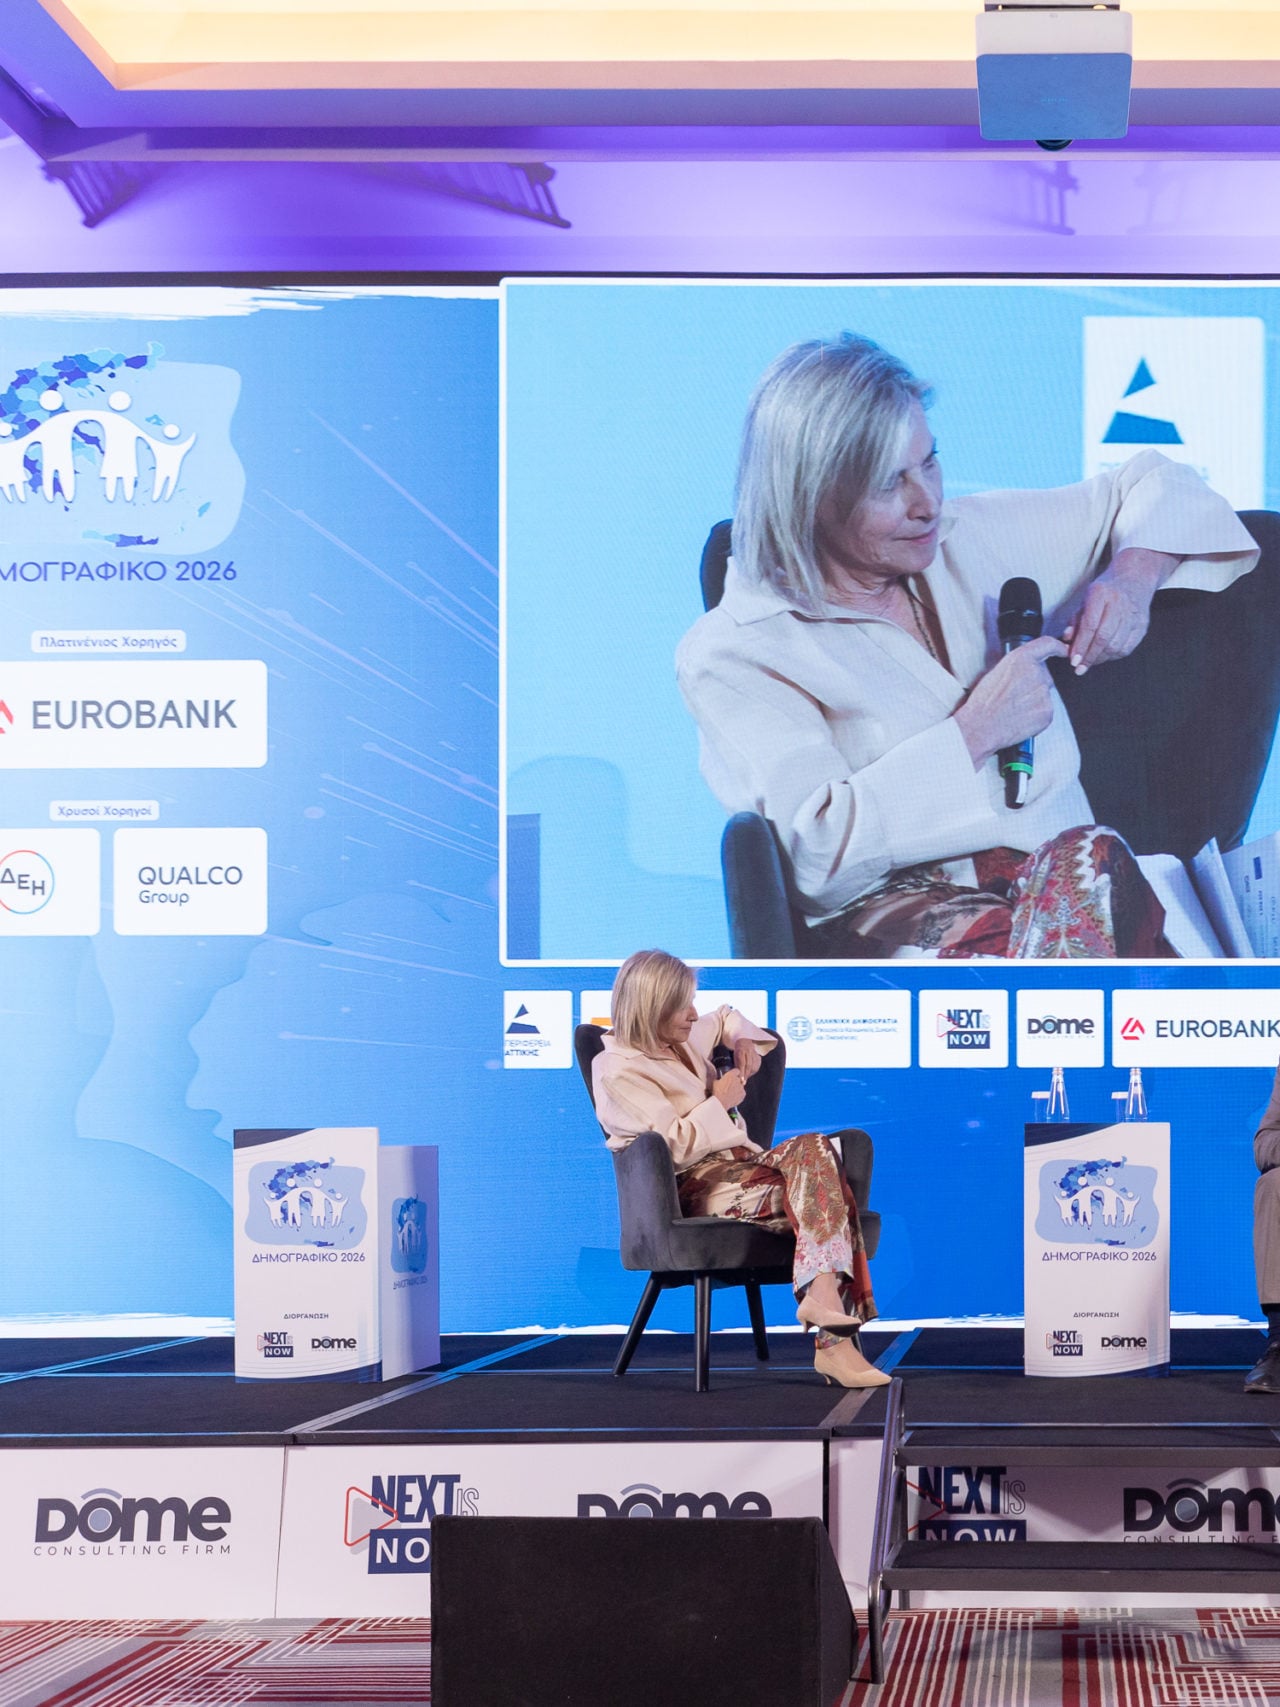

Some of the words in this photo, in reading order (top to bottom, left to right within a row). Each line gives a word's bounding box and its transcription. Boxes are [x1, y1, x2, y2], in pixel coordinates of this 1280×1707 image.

[175, 560, 238, 581] 2026
[122, 636, 177, 649] Χορηγός
[32, 699, 238, 730] EUROBANK
[0, 868, 45, 896] ΔΕΗ
[138, 866, 243, 886] QUALCO
[138, 890, 190, 907] Group
[947, 1009, 982, 1029] NEXT
[949, 1034, 988, 1045] NOW
[252, 1252, 338, 1263] ΔΗΜΟΓΡΑΦΙΚΟ
[341, 1252, 366, 1262] 2026
[1042, 1251, 1128, 1261] ΔΗΜΟΓΡΑΦΙΚΟ
[1132, 1251, 1157, 1261] 2026
[264, 1332, 288, 1344] NEXT
[1053, 1331, 1077, 1343] NEXT
[1054, 1346, 1081, 1354] NOW
[371, 1474, 461, 1522] NEXT
[918, 1466, 1007, 1514] NEXT
[1003, 1480, 1026, 1515] IS
[1123, 1535, 1256, 1543] CONSULTING
[33, 1545, 168, 1556] CONSULTING
[183, 1544, 232, 1555] FIRM
[376, 1537, 431, 1563] NO
